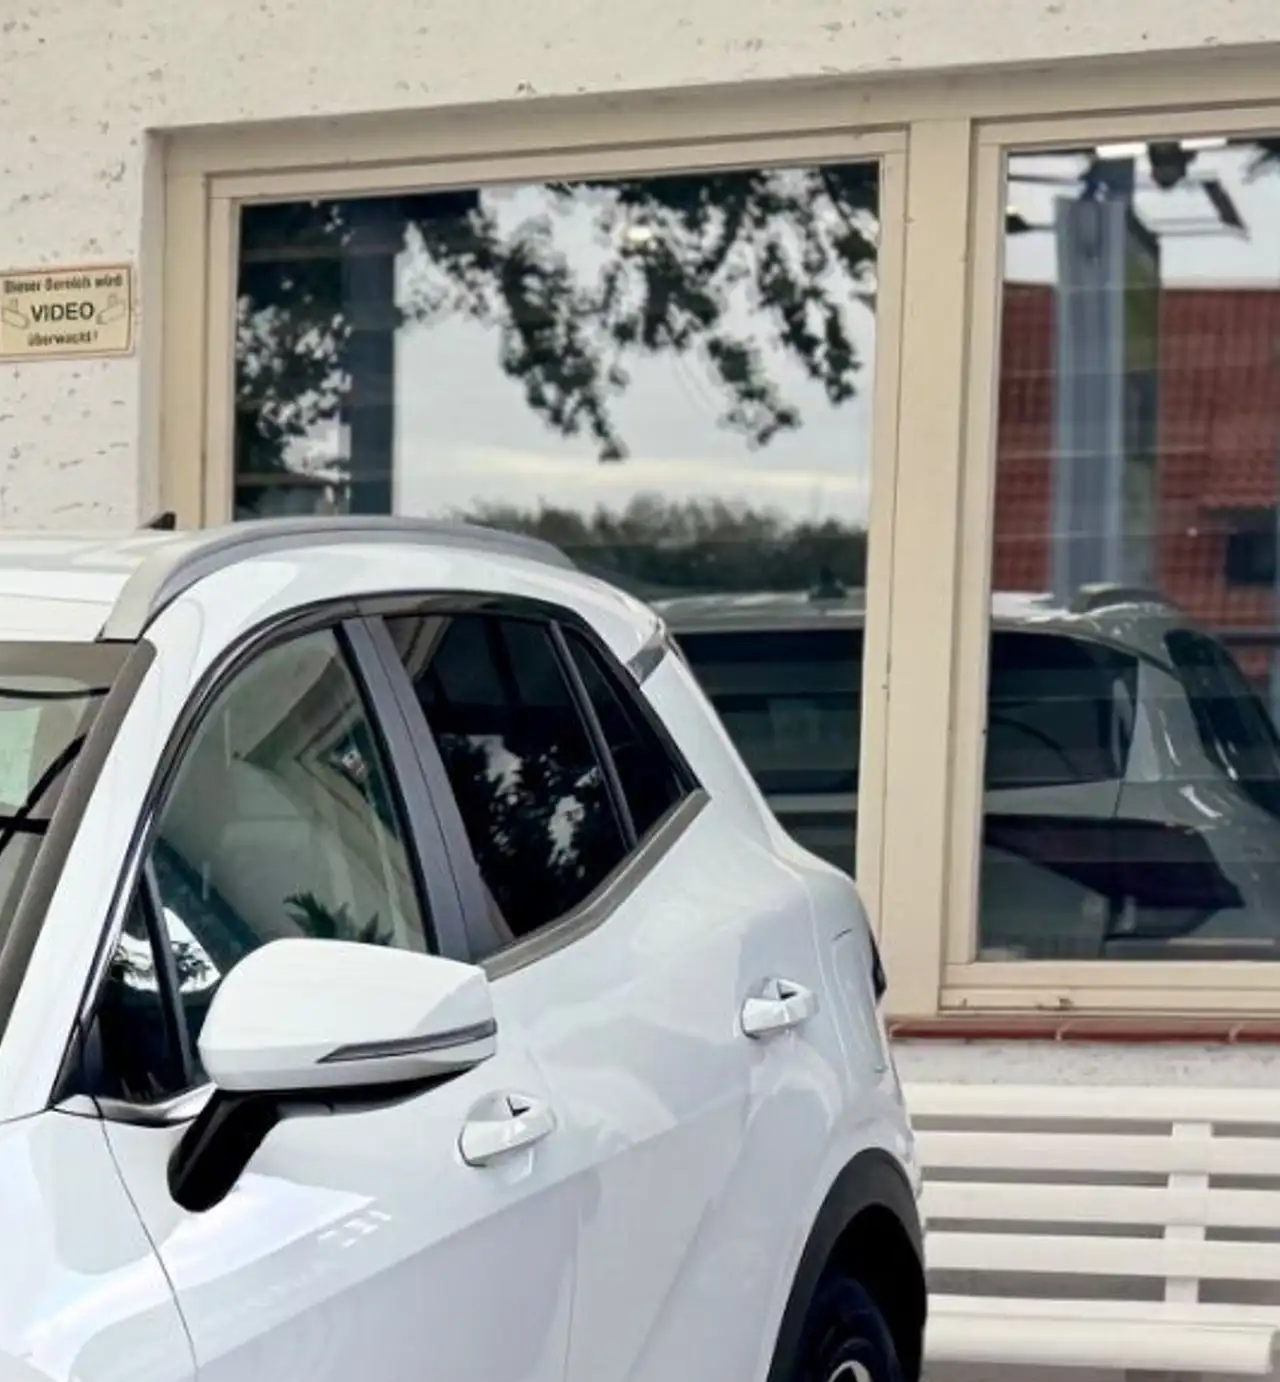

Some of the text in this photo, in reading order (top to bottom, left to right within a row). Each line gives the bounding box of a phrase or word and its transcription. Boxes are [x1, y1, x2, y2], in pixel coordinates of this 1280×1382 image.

[44, 275, 91, 292] Bereich
[95, 273, 123, 287] wird
[30, 301, 95, 322] VIDEO
